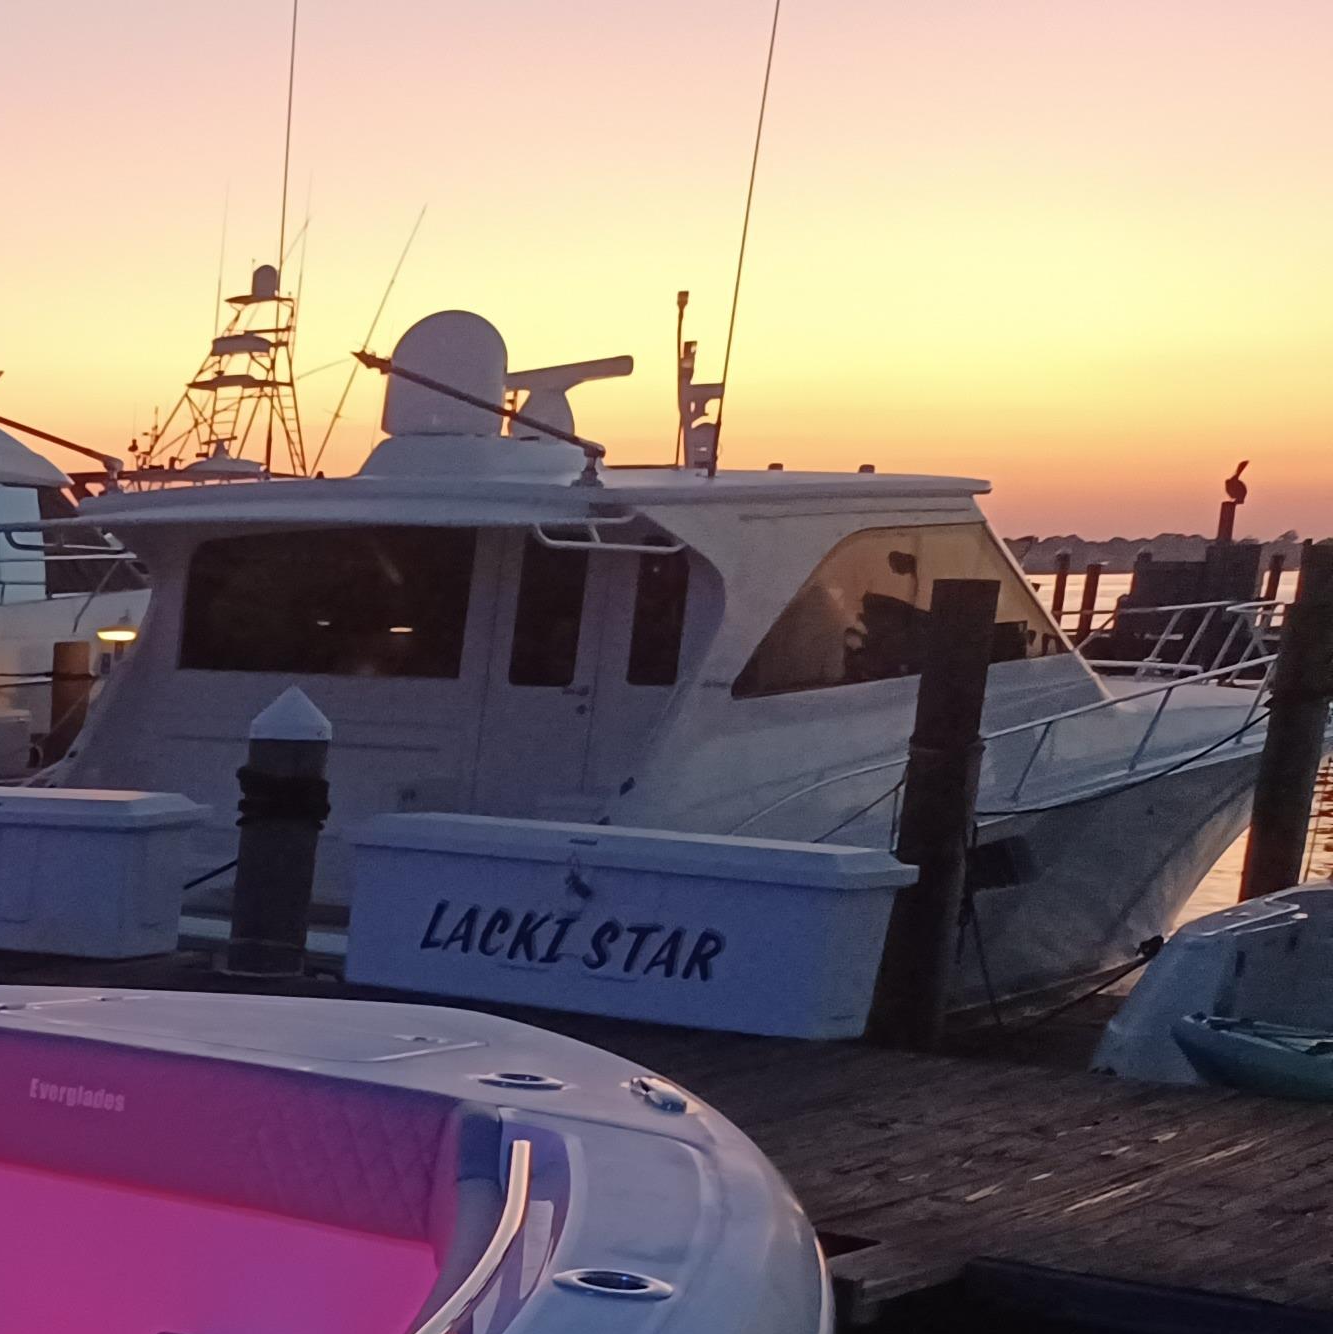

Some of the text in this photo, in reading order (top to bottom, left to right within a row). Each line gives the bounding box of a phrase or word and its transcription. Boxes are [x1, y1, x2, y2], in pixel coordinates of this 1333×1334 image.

[419, 898, 728, 982] LACKI STAR
[29, 1077, 126, 1112] Everglades
